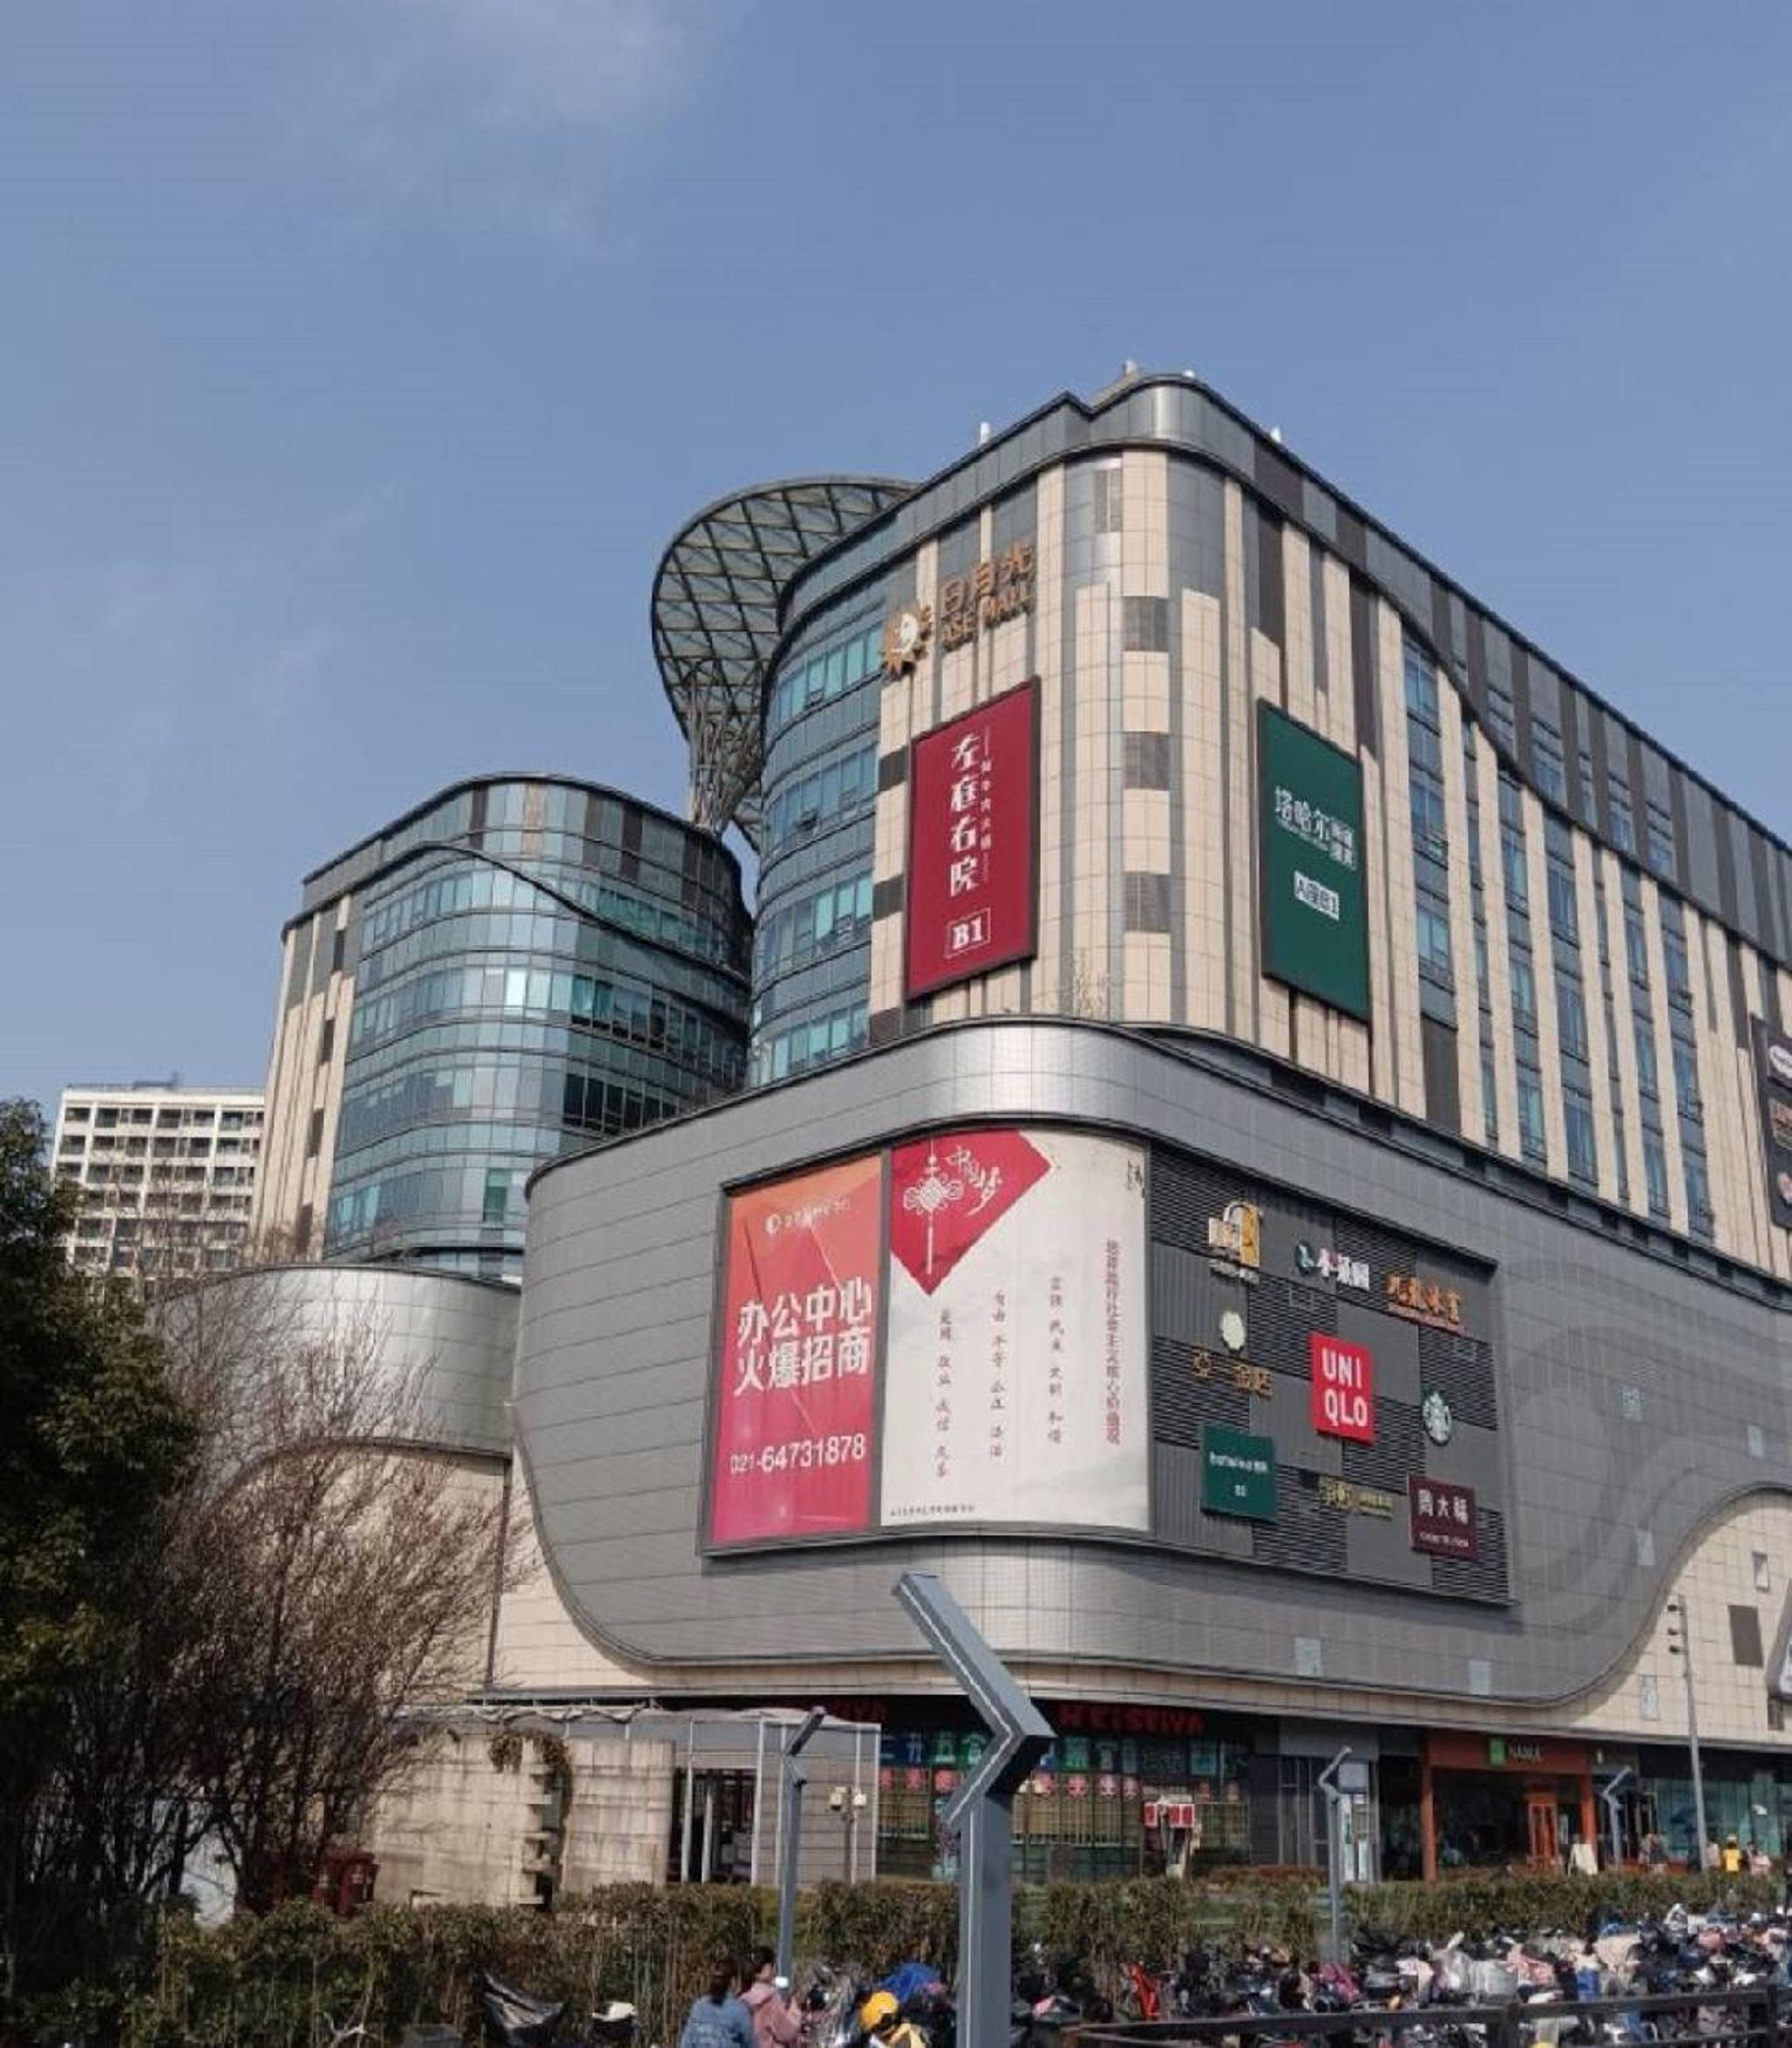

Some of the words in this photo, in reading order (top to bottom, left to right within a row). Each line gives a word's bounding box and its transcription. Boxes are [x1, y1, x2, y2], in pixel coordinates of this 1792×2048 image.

[950, 732, 980, 898] 左庭右院
[952, 916, 983, 950] B1
[738, 1276, 872, 1348] 办公中心
[733, 1326, 872, 1397] 火爆招商
[1321, 1347, 1362, 1389] UNI
[1324, 1388, 1368, 1427] QLO
[730, 1432, 866, 1475] 021-64731878
[1418, 1489, 1469, 1525] 周大福
